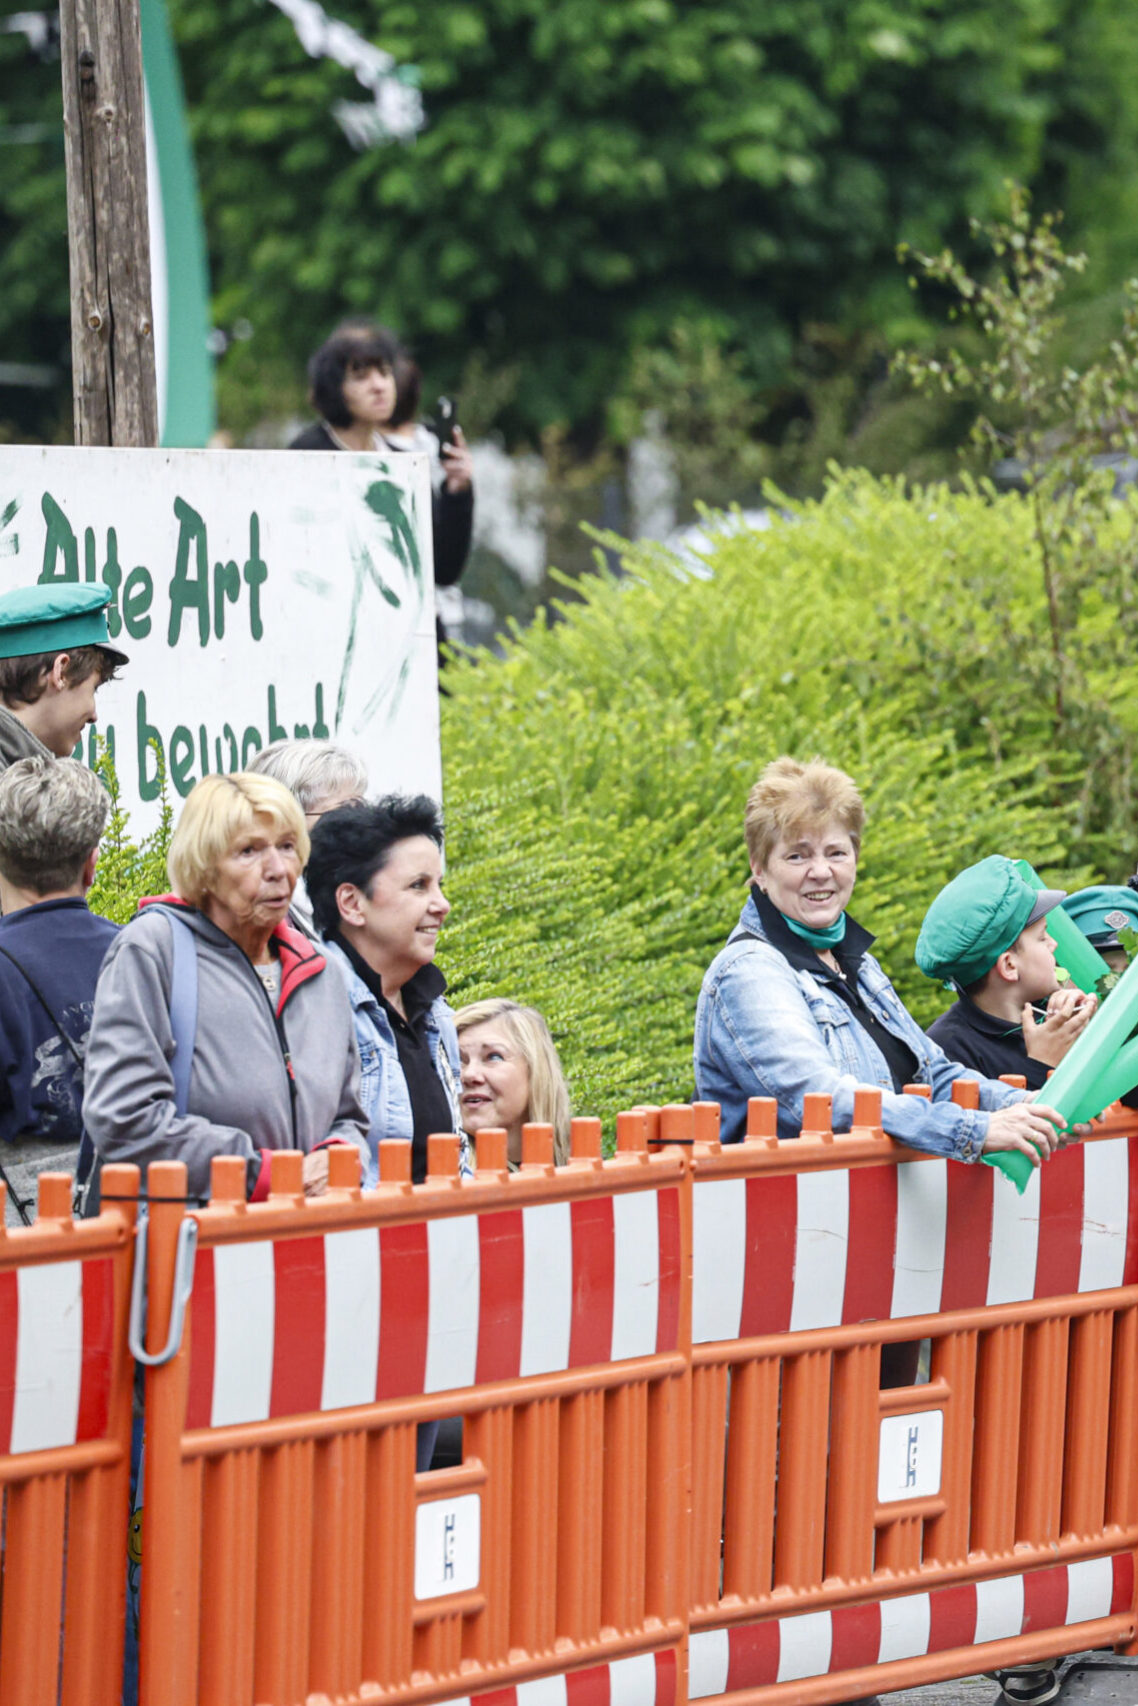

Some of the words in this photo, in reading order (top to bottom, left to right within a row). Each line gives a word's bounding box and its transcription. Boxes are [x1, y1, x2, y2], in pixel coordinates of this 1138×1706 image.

[37, 491, 153, 640] Alte
[168, 496, 268, 647] Art
[137, 682, 328, 802] bewaht
